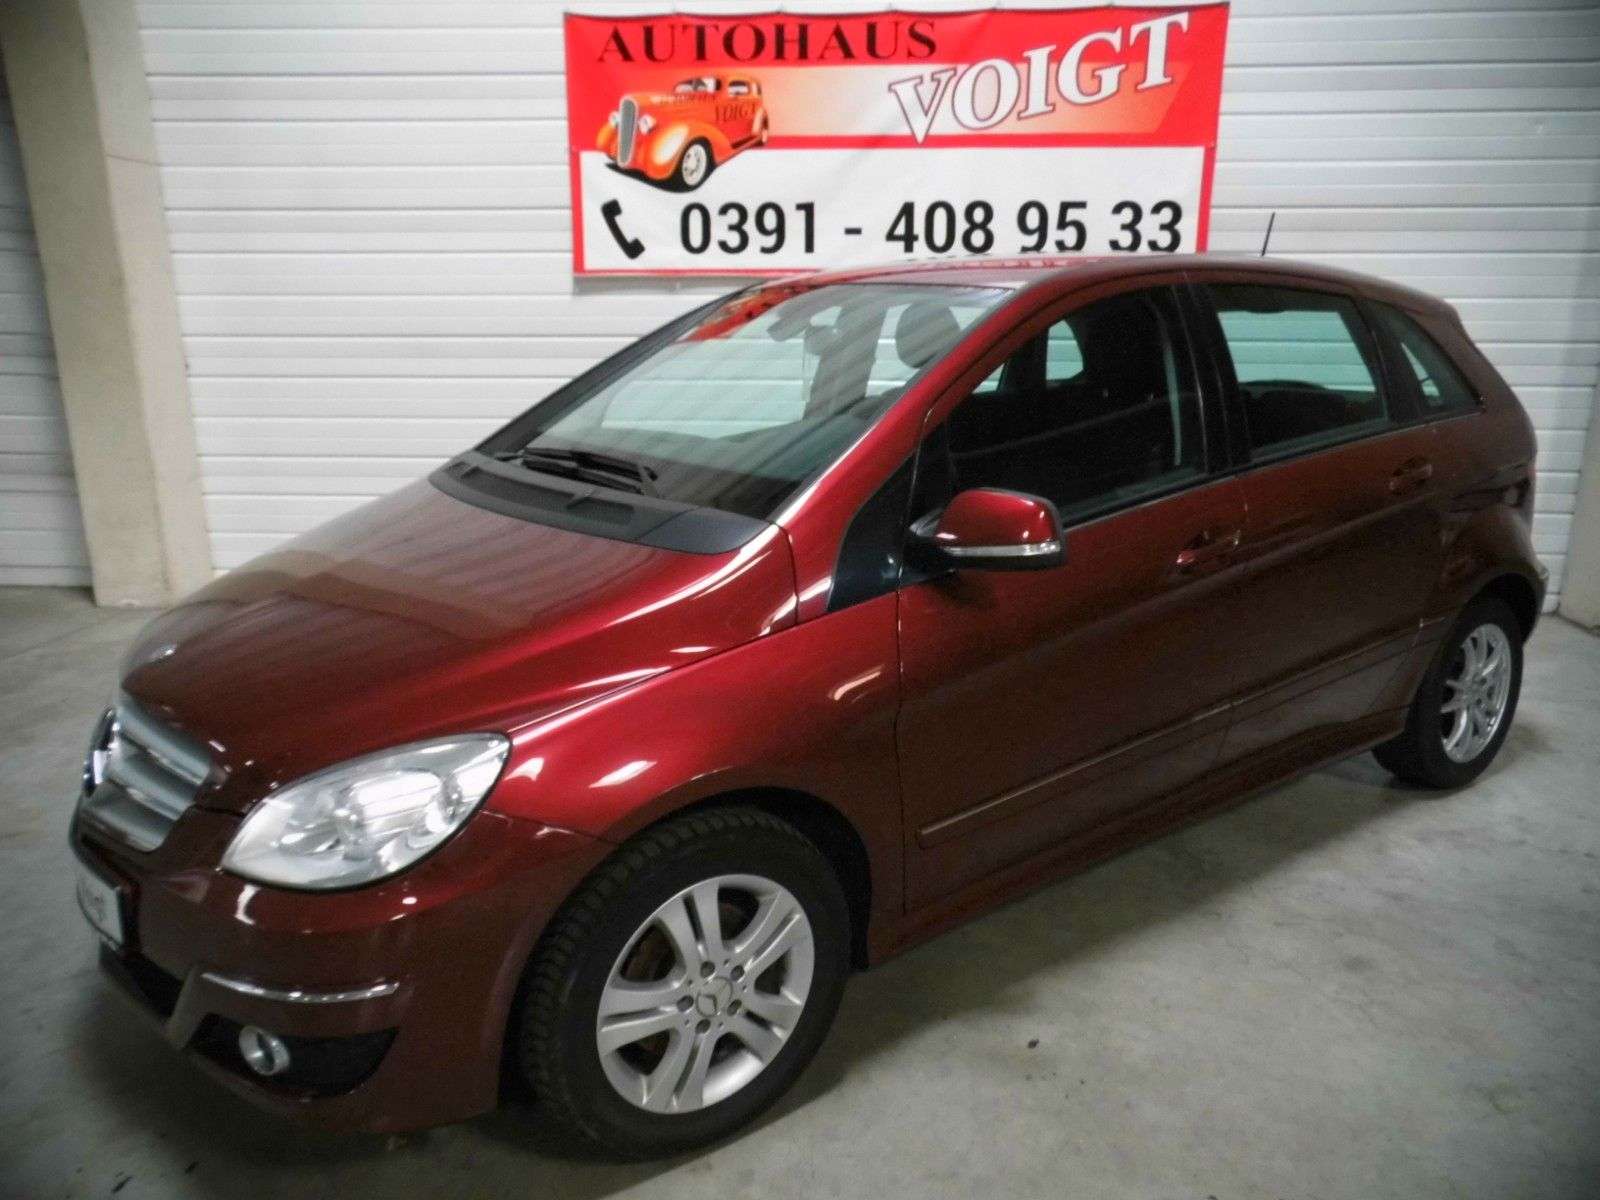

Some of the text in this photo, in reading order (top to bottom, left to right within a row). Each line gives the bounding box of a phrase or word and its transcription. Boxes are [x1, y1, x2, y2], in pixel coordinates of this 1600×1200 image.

[598, 21, 936, 64] AUTOHAUS
[888, 12, 1190, 145] VOIGT
[680, 201, 816, 255] 0391
[884, 200, 995, 255] 408
[1015, 200, 1088, 254] 95
[1108, 200, 1183, 254] 33
